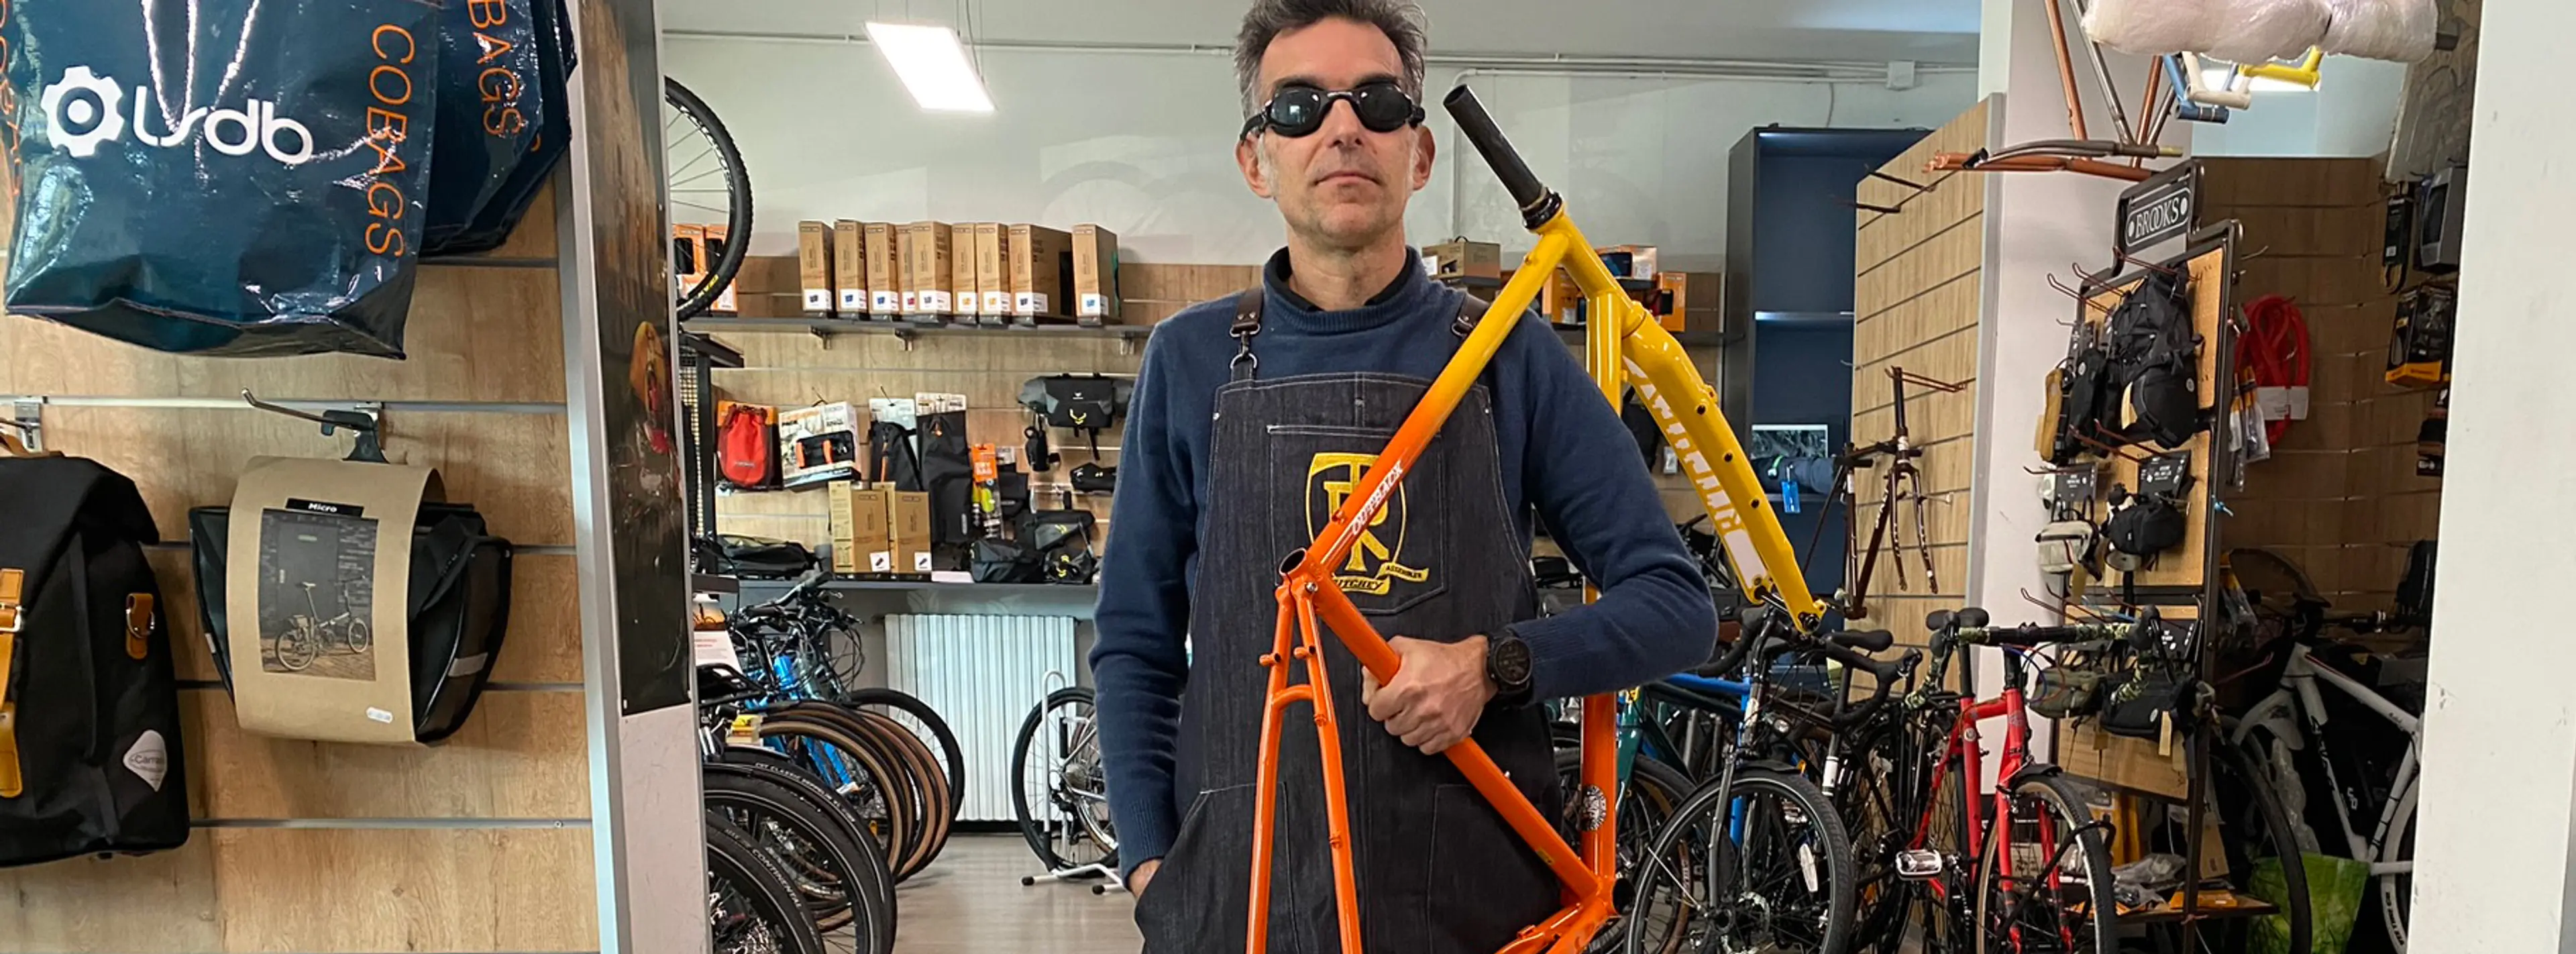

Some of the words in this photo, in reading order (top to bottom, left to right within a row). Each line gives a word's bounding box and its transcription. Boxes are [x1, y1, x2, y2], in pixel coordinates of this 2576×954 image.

[365, 24, 415, 257] COBAGS
[2135, 197, 2179, 238] BROOKS
[308, 502, 337, 513] Micro
[1351, 459, 1403, 535] OUTBACK
[1334, 578, 1384, 592] ITCHEY
[1385, 566, 1422, 579] ASSEMBLER
[752, 848, 802, 908] CONTINENTAL
